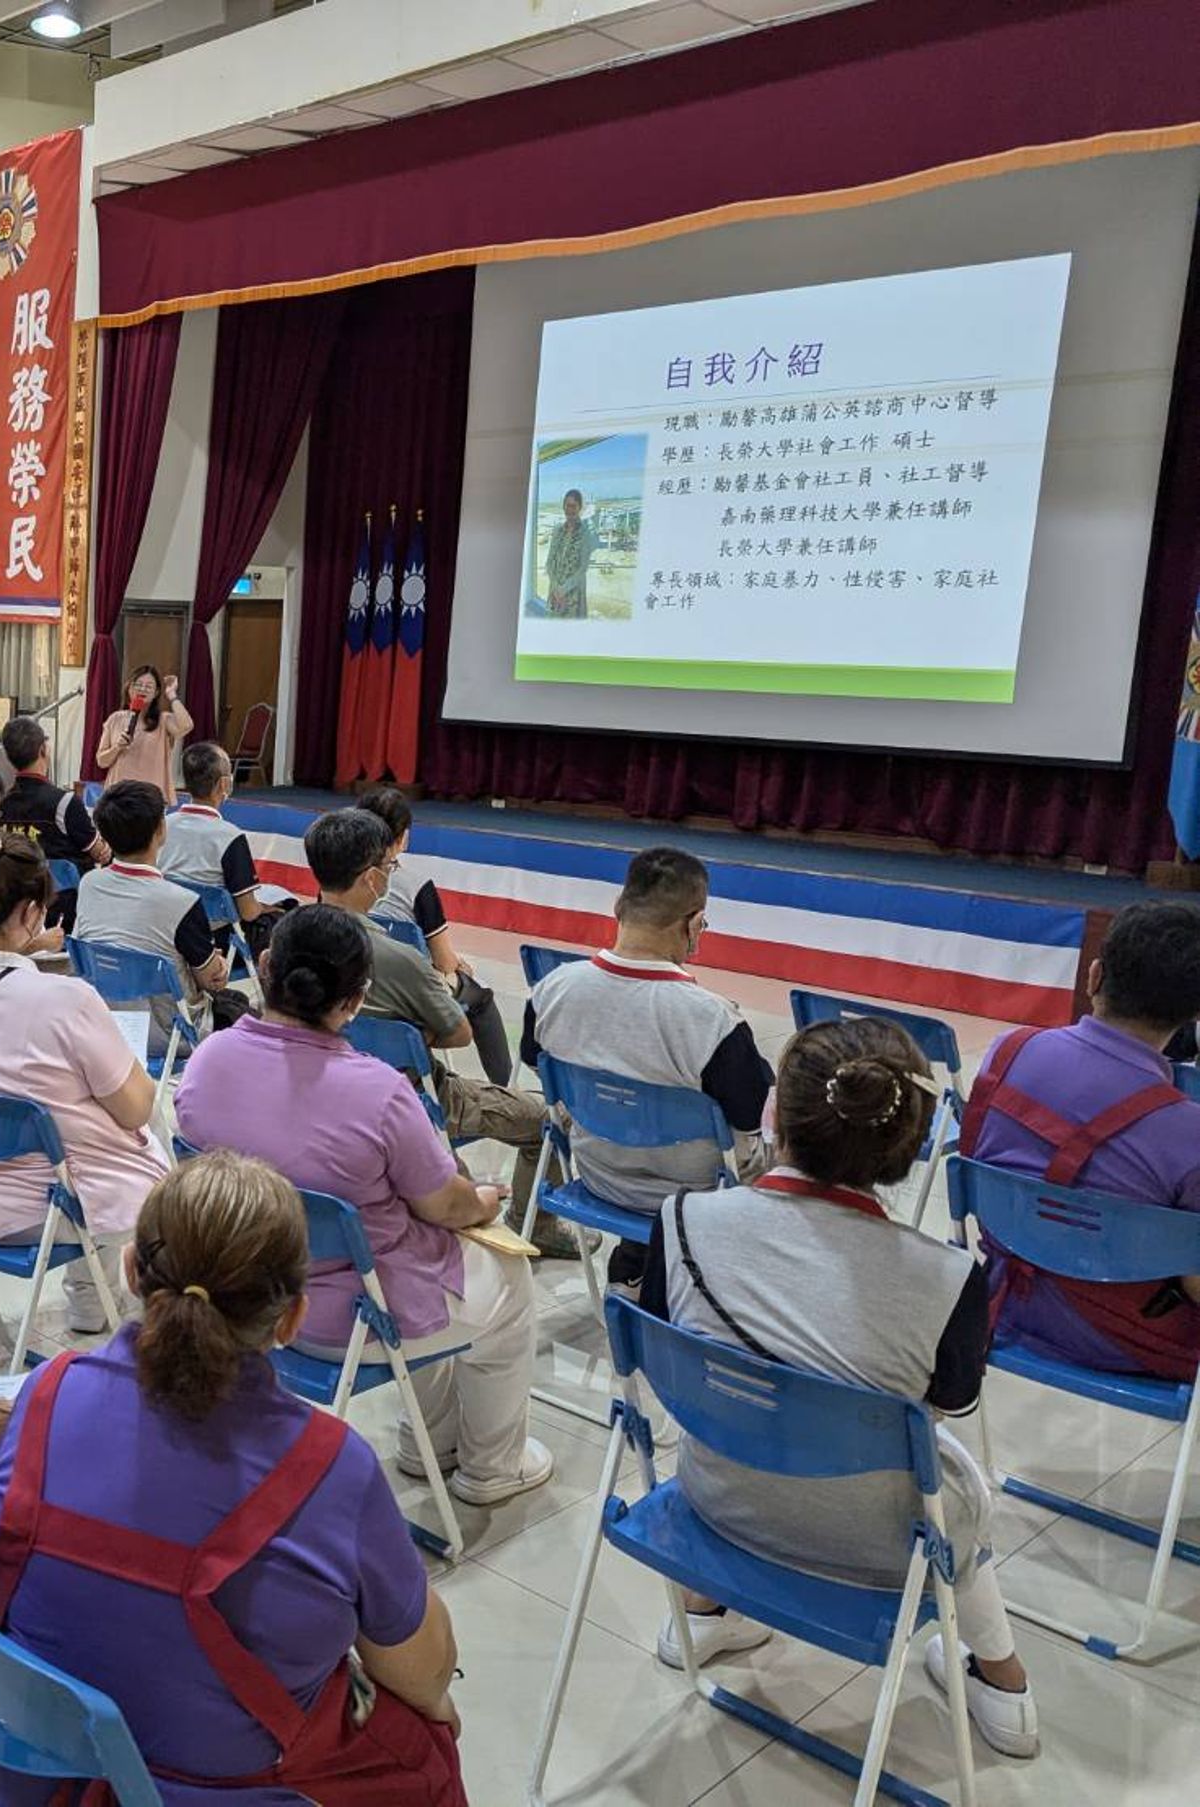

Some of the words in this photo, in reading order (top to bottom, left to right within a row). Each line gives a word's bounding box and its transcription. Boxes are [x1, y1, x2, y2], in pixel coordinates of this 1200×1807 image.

[666, 341, 824, 391] 自我介紹
[6, 288, 55, 583] 服務榮民
[891, 429, 936, 451] 碩士
[720, 498, 973, 528] 嘉南藥理科技大學兼任講師
[717, 535, 879, 558] 長榮大學兼任講師
[644, 593, 695, 611] 會工作
